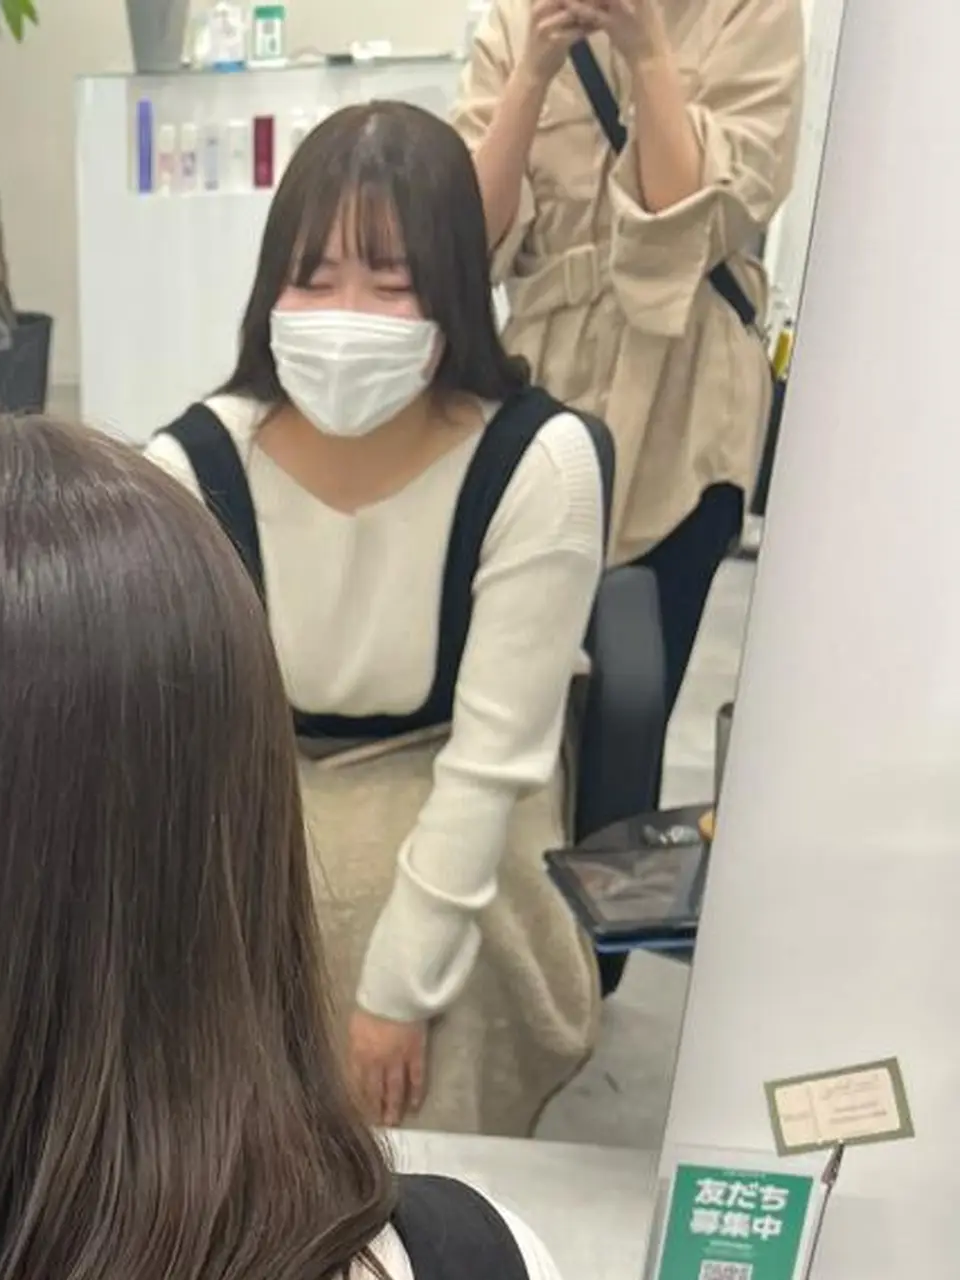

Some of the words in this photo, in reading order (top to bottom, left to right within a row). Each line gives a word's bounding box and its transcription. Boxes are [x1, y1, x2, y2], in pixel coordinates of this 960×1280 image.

[695, 1178, 789, 1211] 友だち
[690, 1207, 783, 1240] 募集中
